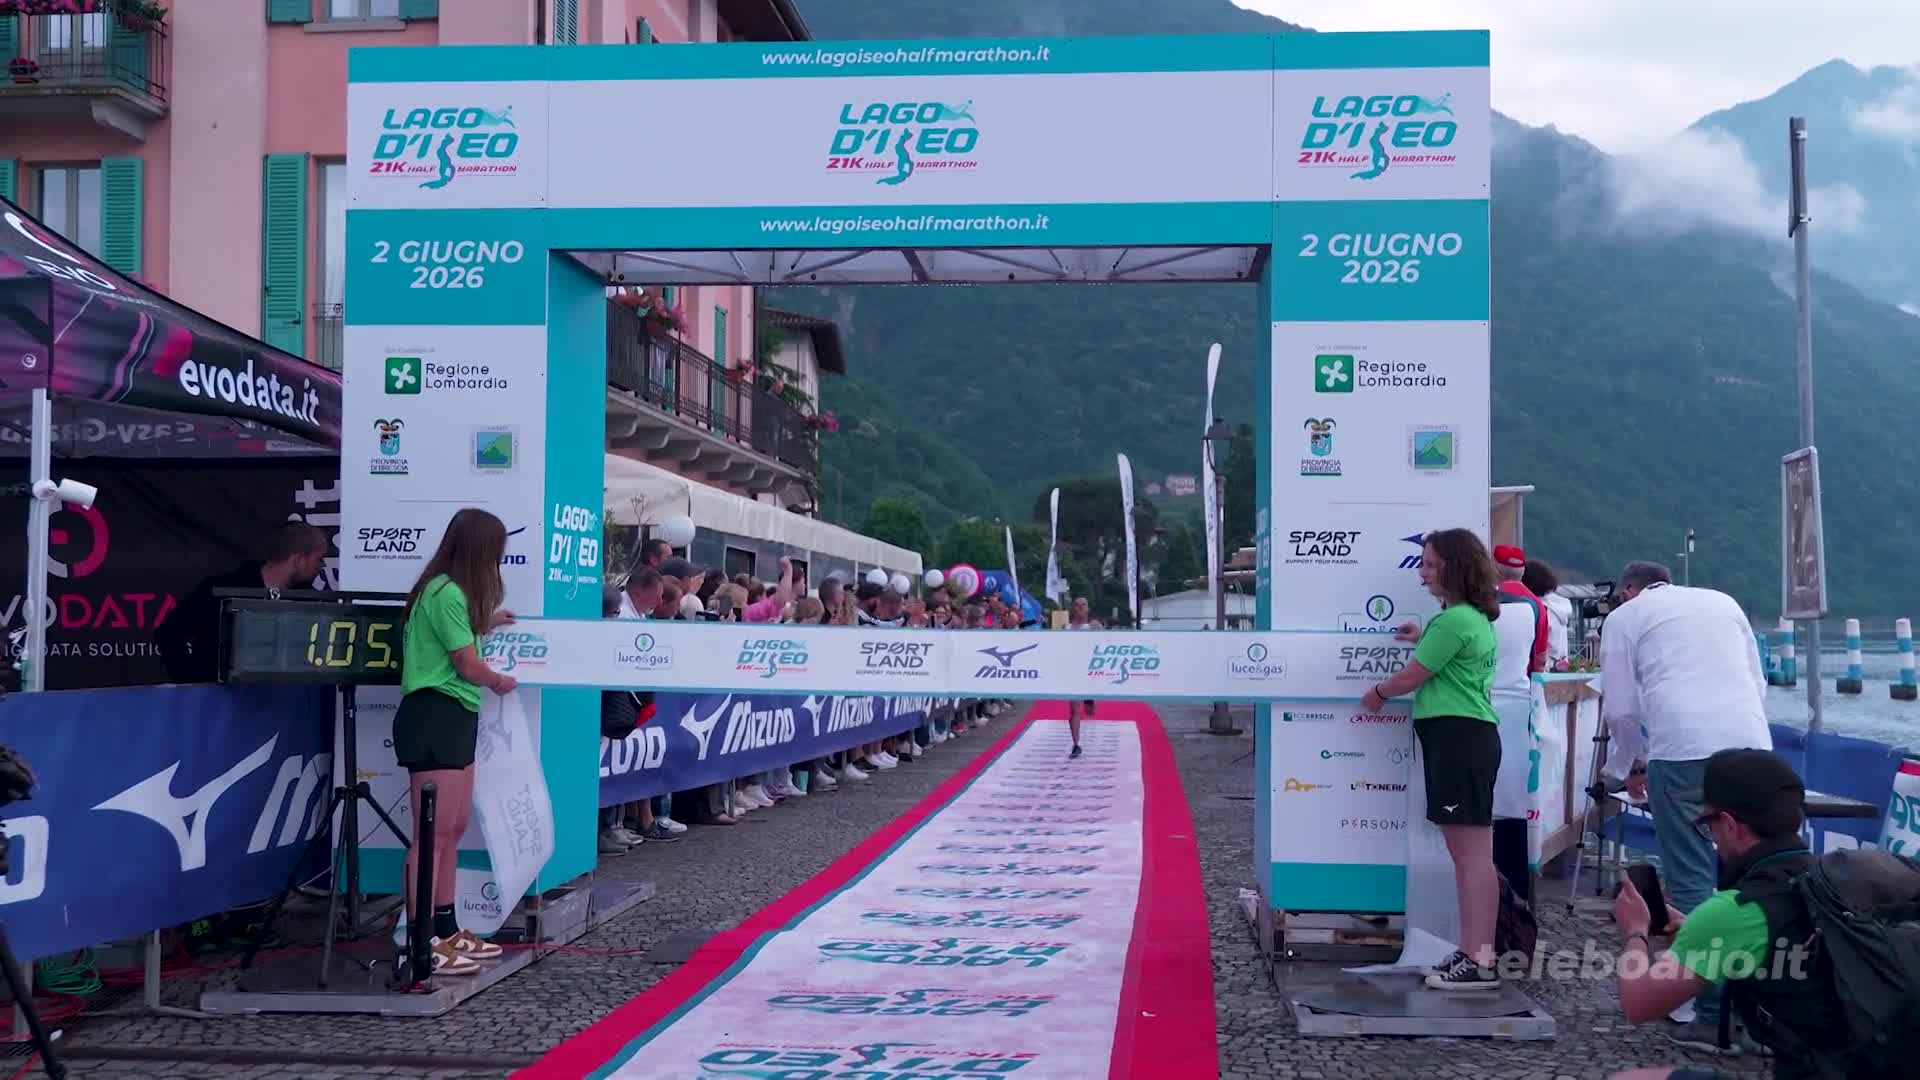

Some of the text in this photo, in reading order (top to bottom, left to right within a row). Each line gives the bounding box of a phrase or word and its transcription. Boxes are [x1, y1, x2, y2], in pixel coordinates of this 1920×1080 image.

[762, 45, 1050, 68] www.lagoiseohalfmarathon.it
[839, 102, 944, 125] LAGO
[1311, 95, 1421, 118] LAGO
[382, 107, 486, 130] LAGO
[826, 158, 865, 169] 21K
[865, 161, 895, 169] HALF
[1297, 152, 1456, 163] 21K HALF MARATHON
[369, 162, 408, 174] 21K
[760, 214, 1050, 235] www.lagoiseohalfmarathon.it
[371, 239, 525, 264] 2 GIUGNO
[1299, 232, 1464, 257] 2 GIUGNO
[409, 266, 486, 289] 2026
[1340, 259, 1421, 284] 2026
[425, 362, 490, 377] Regione
[1358, 360, 1428, 376] Regione
[425, 377, 508, 390] Lombardia
[1358, 375, 1448, 388] Lombardia
[179, 359, 320, 427] evodata.it
[553, 503, 590, 533] LAGO
[363, 540, 417, 552] LAND
[1295, 544, 1352, 557] LAND
[742, 639, 793, 651] LAGO
[1093, 645, 1145, 657] LAGO
[618, 652, 669, 667] luce&gas
[866, 655, 925, 669] LAND
[1345, 660, 1406, 674] LAND
[1231, 662, 1283, 677] luce&gas
